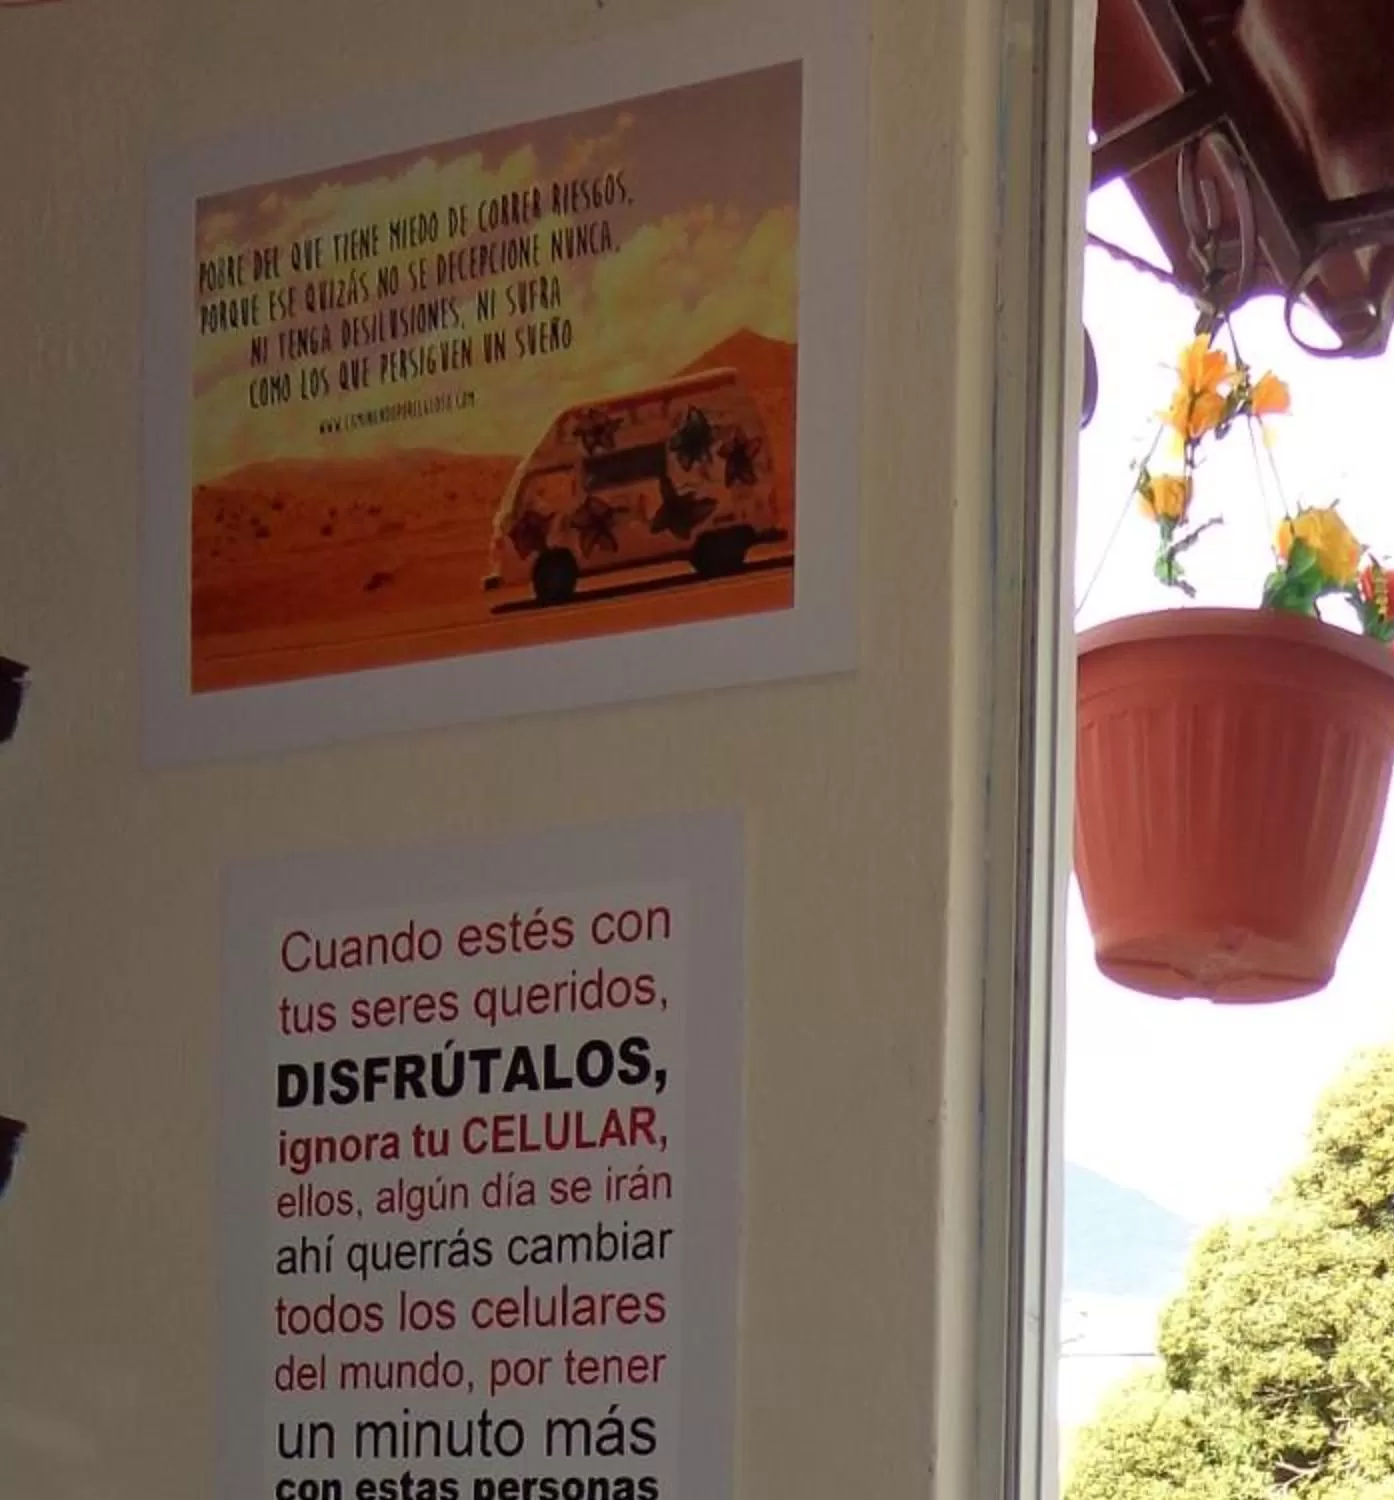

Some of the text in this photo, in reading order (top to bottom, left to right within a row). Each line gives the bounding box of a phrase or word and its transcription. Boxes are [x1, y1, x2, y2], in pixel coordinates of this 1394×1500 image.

[199, 255, 244, 296] POBRE
[253, 247, 281, 281] DEL
[292, 237, 323, 272] QUE
[333, 223, 380, 263] TIENE
[390, 210, 438, 251] MIEDO
[449, 205, 468, 238] DE
[479, 187, 541, 233] CORRER
[199, 295, 259, 337] PORQUE
[269, 286, 297, 321] ESE
[305, 267, 369, 313] QUIZÁS
[378, 266, 399, 300] NO
[409, 258, 428, 292] SE
[438, 234, 540, 287] DECEPCIONE
[251, 336, 268, 369] NI
[279, 323, 331, 360] TENGA
[478, 290, 496, 321] NI
[506, 275, 561, 317] SUFRA
[249, 316, 574, 409] COMO LOS QUE PERSIGUEN UN SUEÑO
[281, 906, 671, 973] Cuando estés con
[278, 966, 668, 1036] tus seres queridos,
[276, 1035, 667, 1109] DISFRÚTALOS,
[279, 1105, 668, 1176] ignora tu CELULAR,
[277, 1163, 673, 1222] ellos, algún día se irán
[276, 1219, 675, 1282] ahí querrás cambiar
[274, 1283, 667, 1336] todos los celulares
[274, 1348, 668, 1398] del mundo, por tener
[278, 1403, 657, 1460] un minuto más
